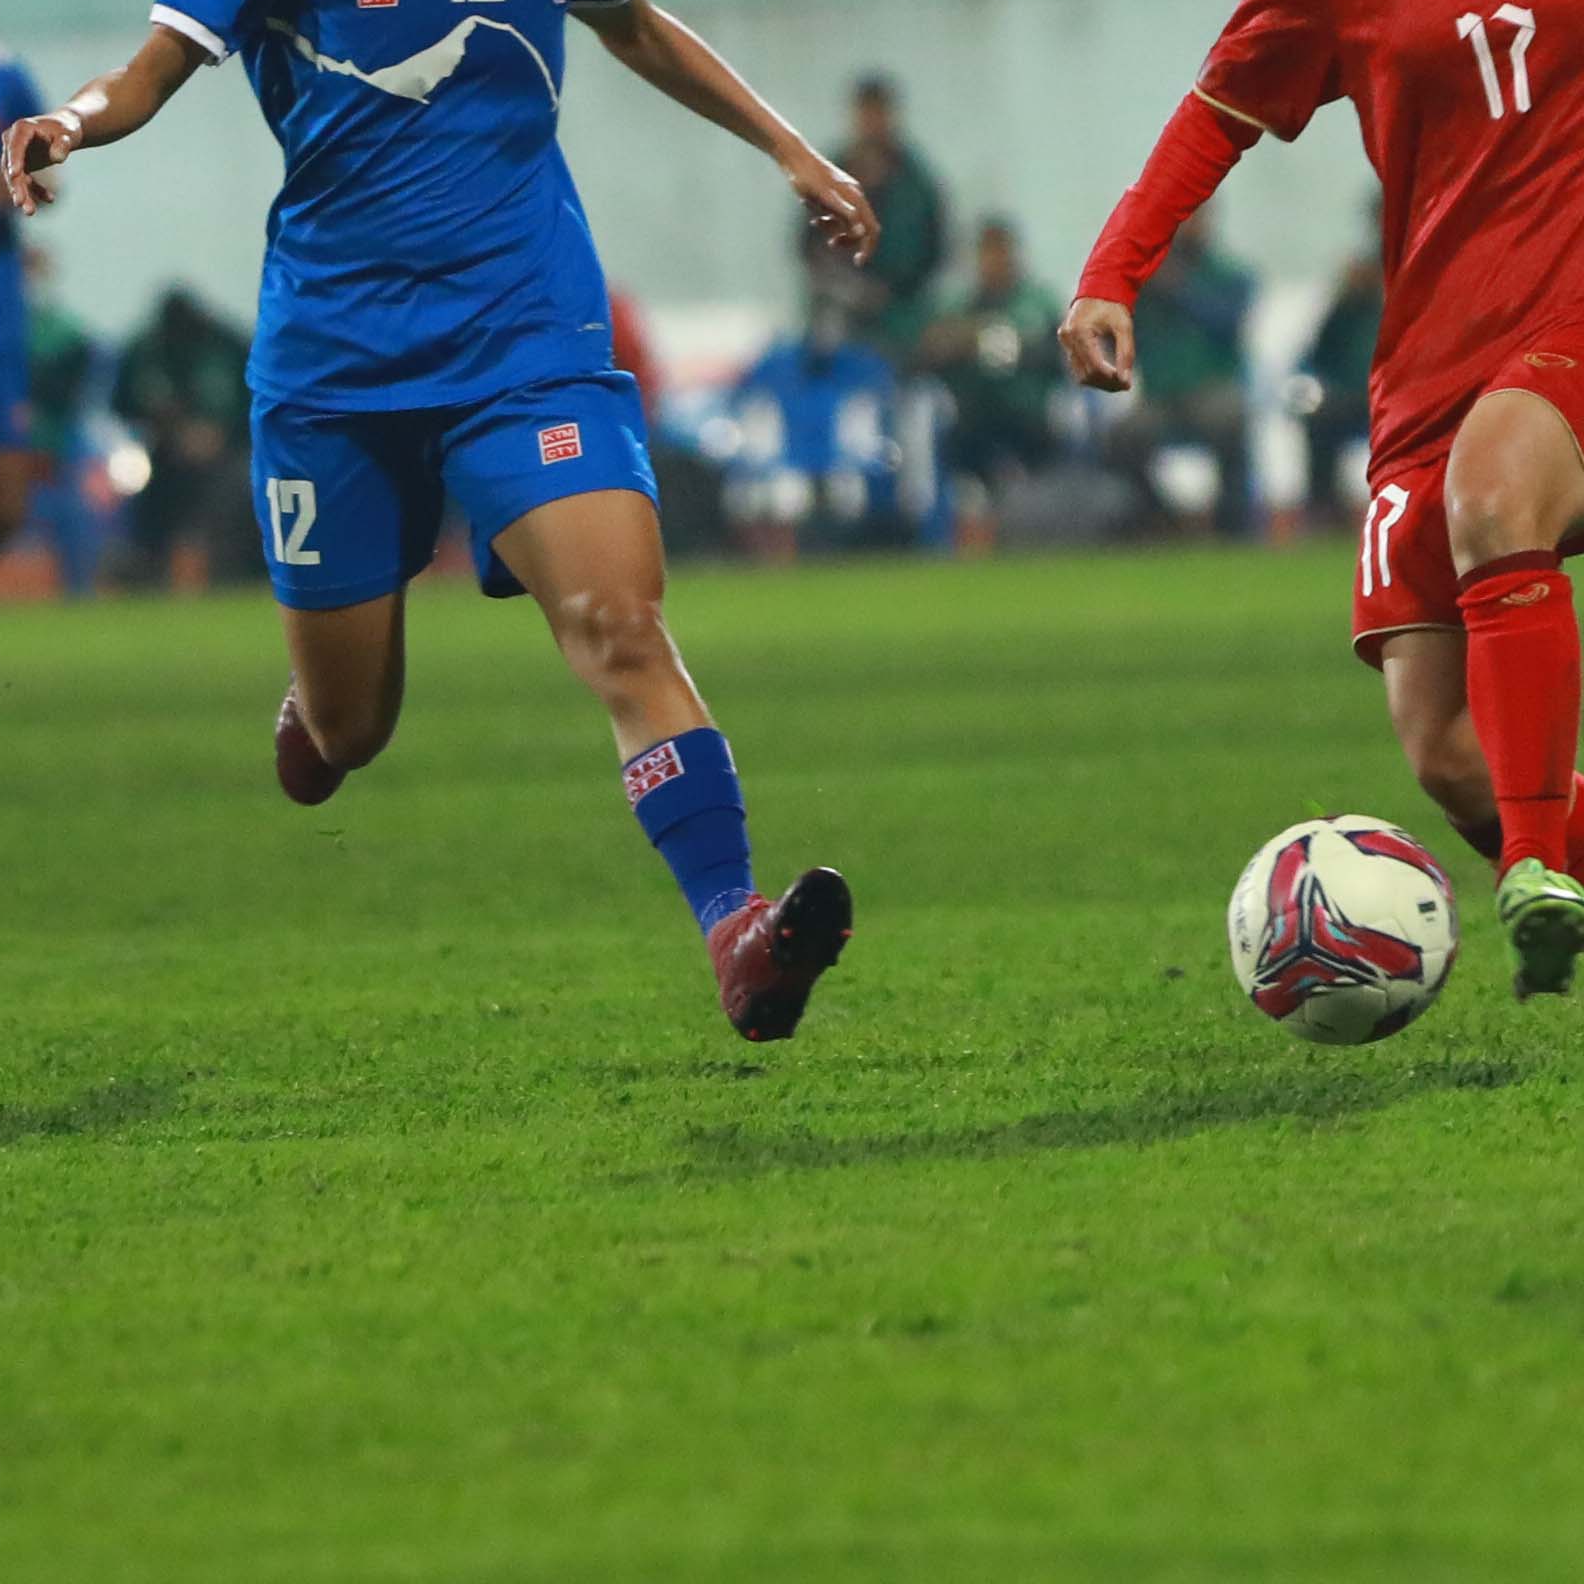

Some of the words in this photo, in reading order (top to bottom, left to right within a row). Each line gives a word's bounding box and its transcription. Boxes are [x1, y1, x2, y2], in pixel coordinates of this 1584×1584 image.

[1455, 2, 1536, 120] 17
[543, 427, 575, 443] KTM
[265, 477, 321, 565] 12
[1361, 483, 1411, 597] 17
